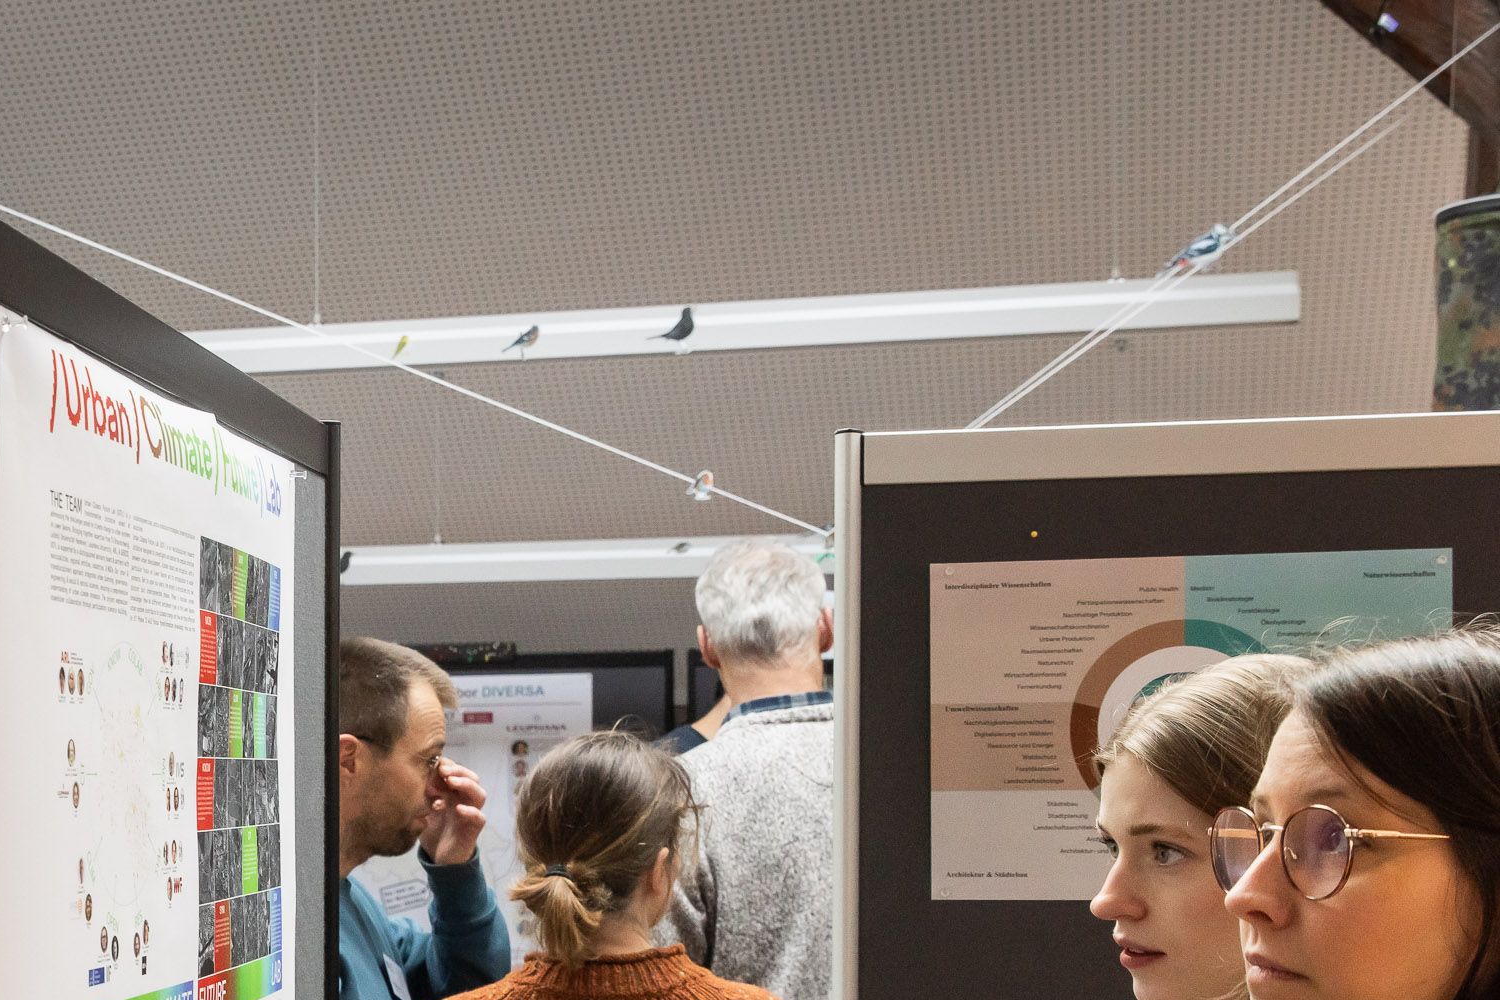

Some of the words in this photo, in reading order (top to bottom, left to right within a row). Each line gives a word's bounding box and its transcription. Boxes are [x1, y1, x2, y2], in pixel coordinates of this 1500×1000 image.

[50, 489, 63, 509] THE
[66, 493, 83, 515] TEAM
[481, 684, 545, 699] DIVERSA
[271, 959, 281, 986] LAB
